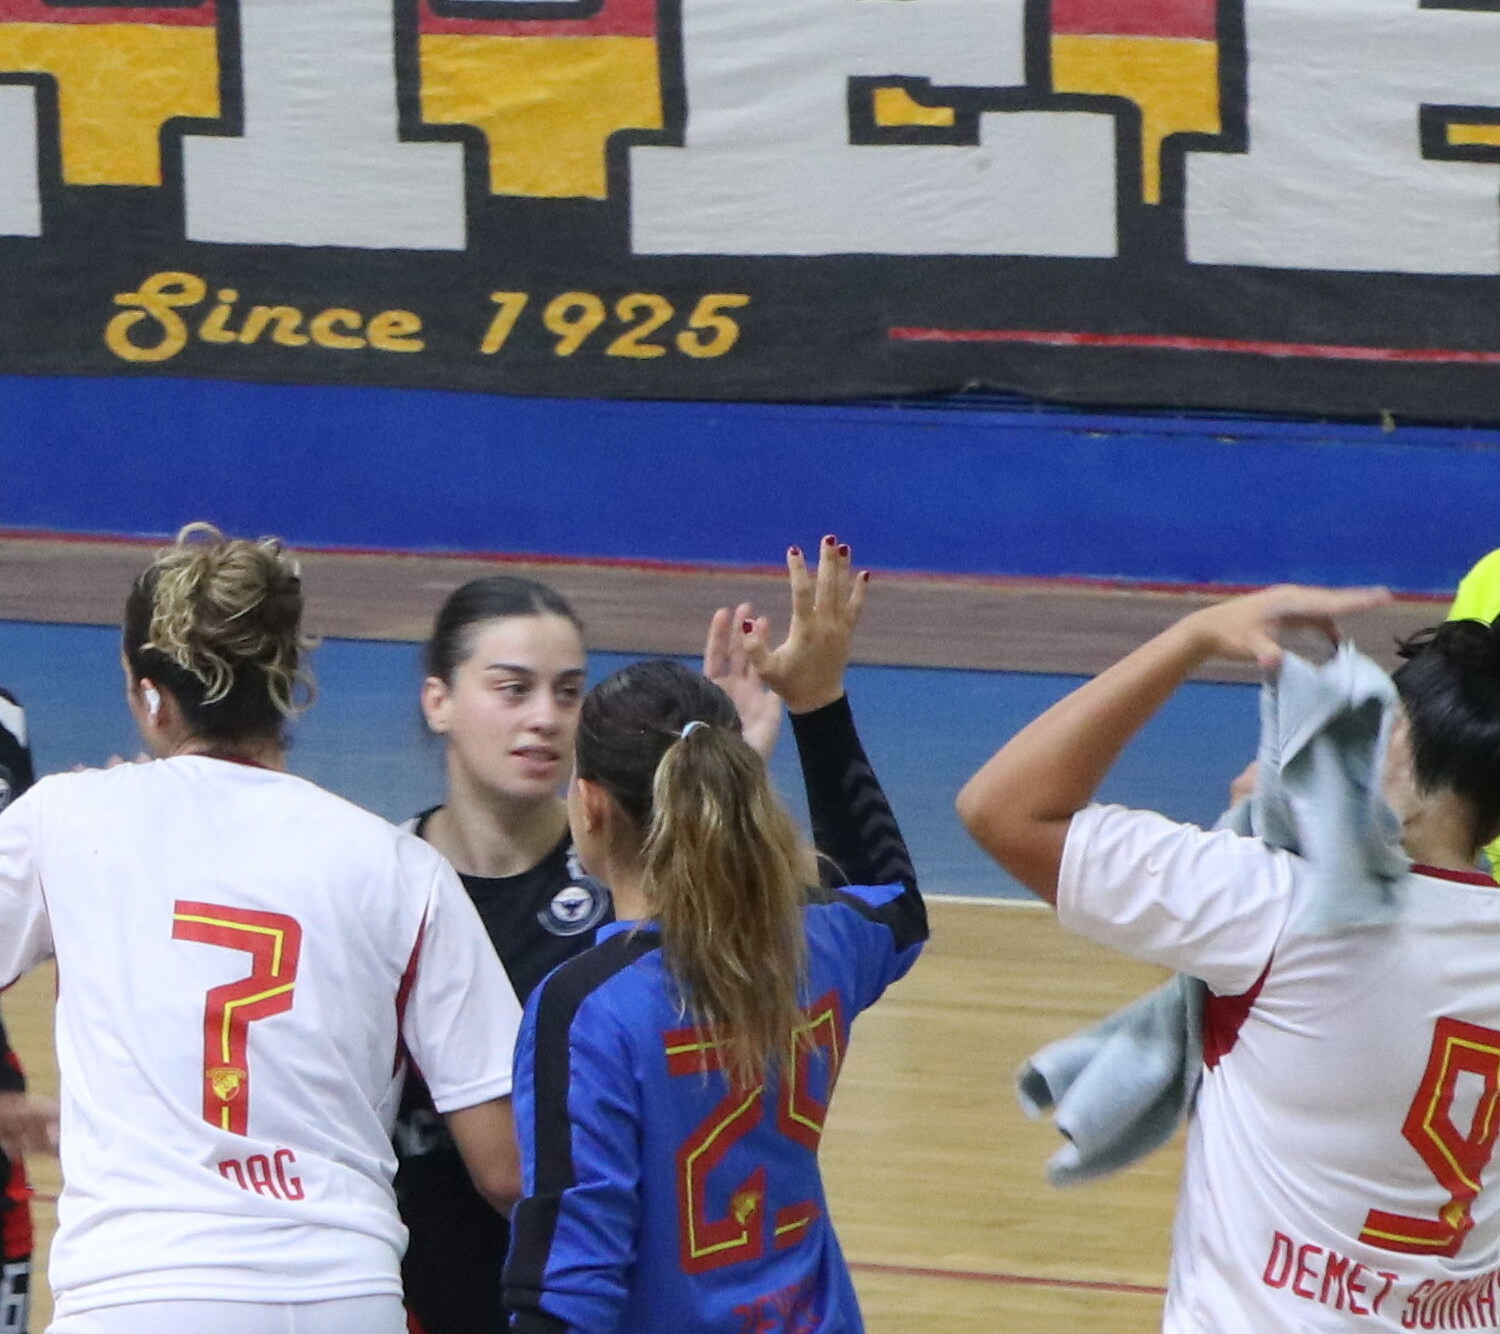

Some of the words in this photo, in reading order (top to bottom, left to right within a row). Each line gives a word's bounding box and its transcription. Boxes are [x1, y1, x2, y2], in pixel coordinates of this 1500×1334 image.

[104, 271, 425, 362] Since
[480, 291, 751, 358] 1925
[172, 899, 303, 1136] 7
[1262, 1230, 1399, 1316] DEMET
